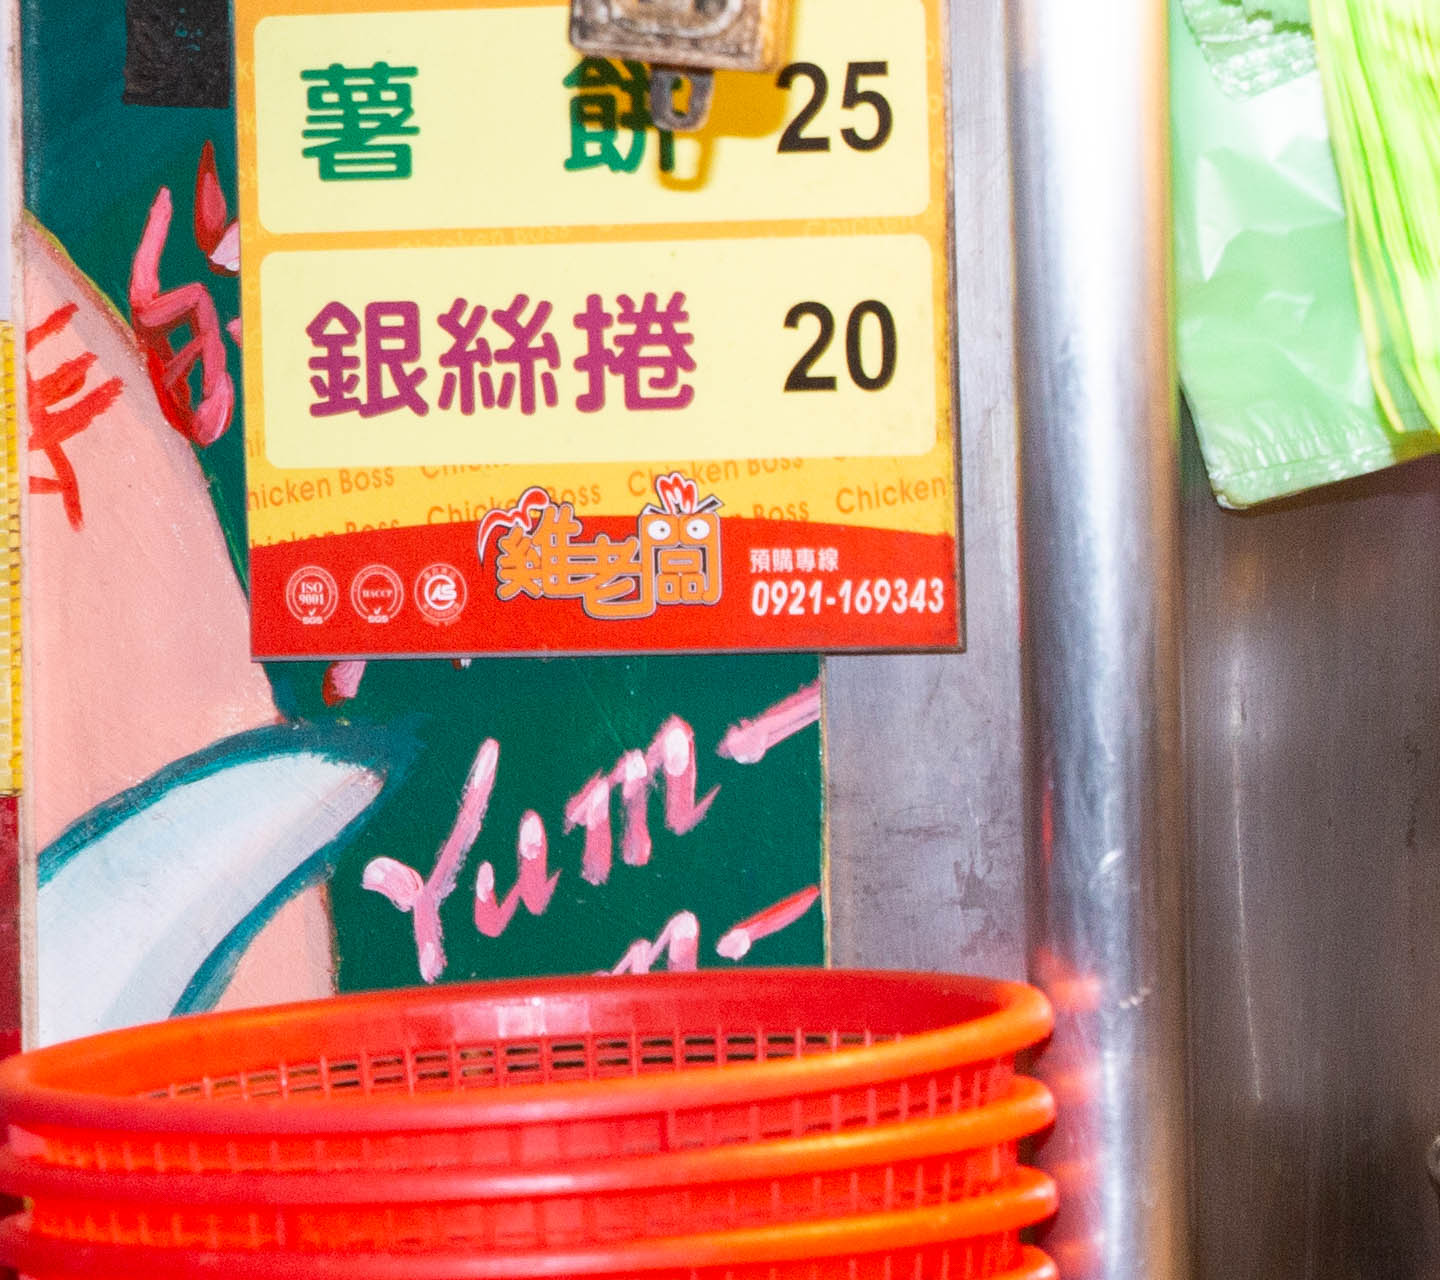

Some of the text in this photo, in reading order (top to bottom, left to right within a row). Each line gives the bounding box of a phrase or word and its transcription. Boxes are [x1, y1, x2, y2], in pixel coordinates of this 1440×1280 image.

[775, 61, 894, 154] 25
[306, 291, 897, 418] 銀絲捲 20
[339, 466, 395, 495] Boss
[836, 477, 947, 514] Chicken
[750, 547, 839, 572] 預購專線
[301, 581, 323, 594] ISO
[751, 577, 945, 617] 0921-169343
